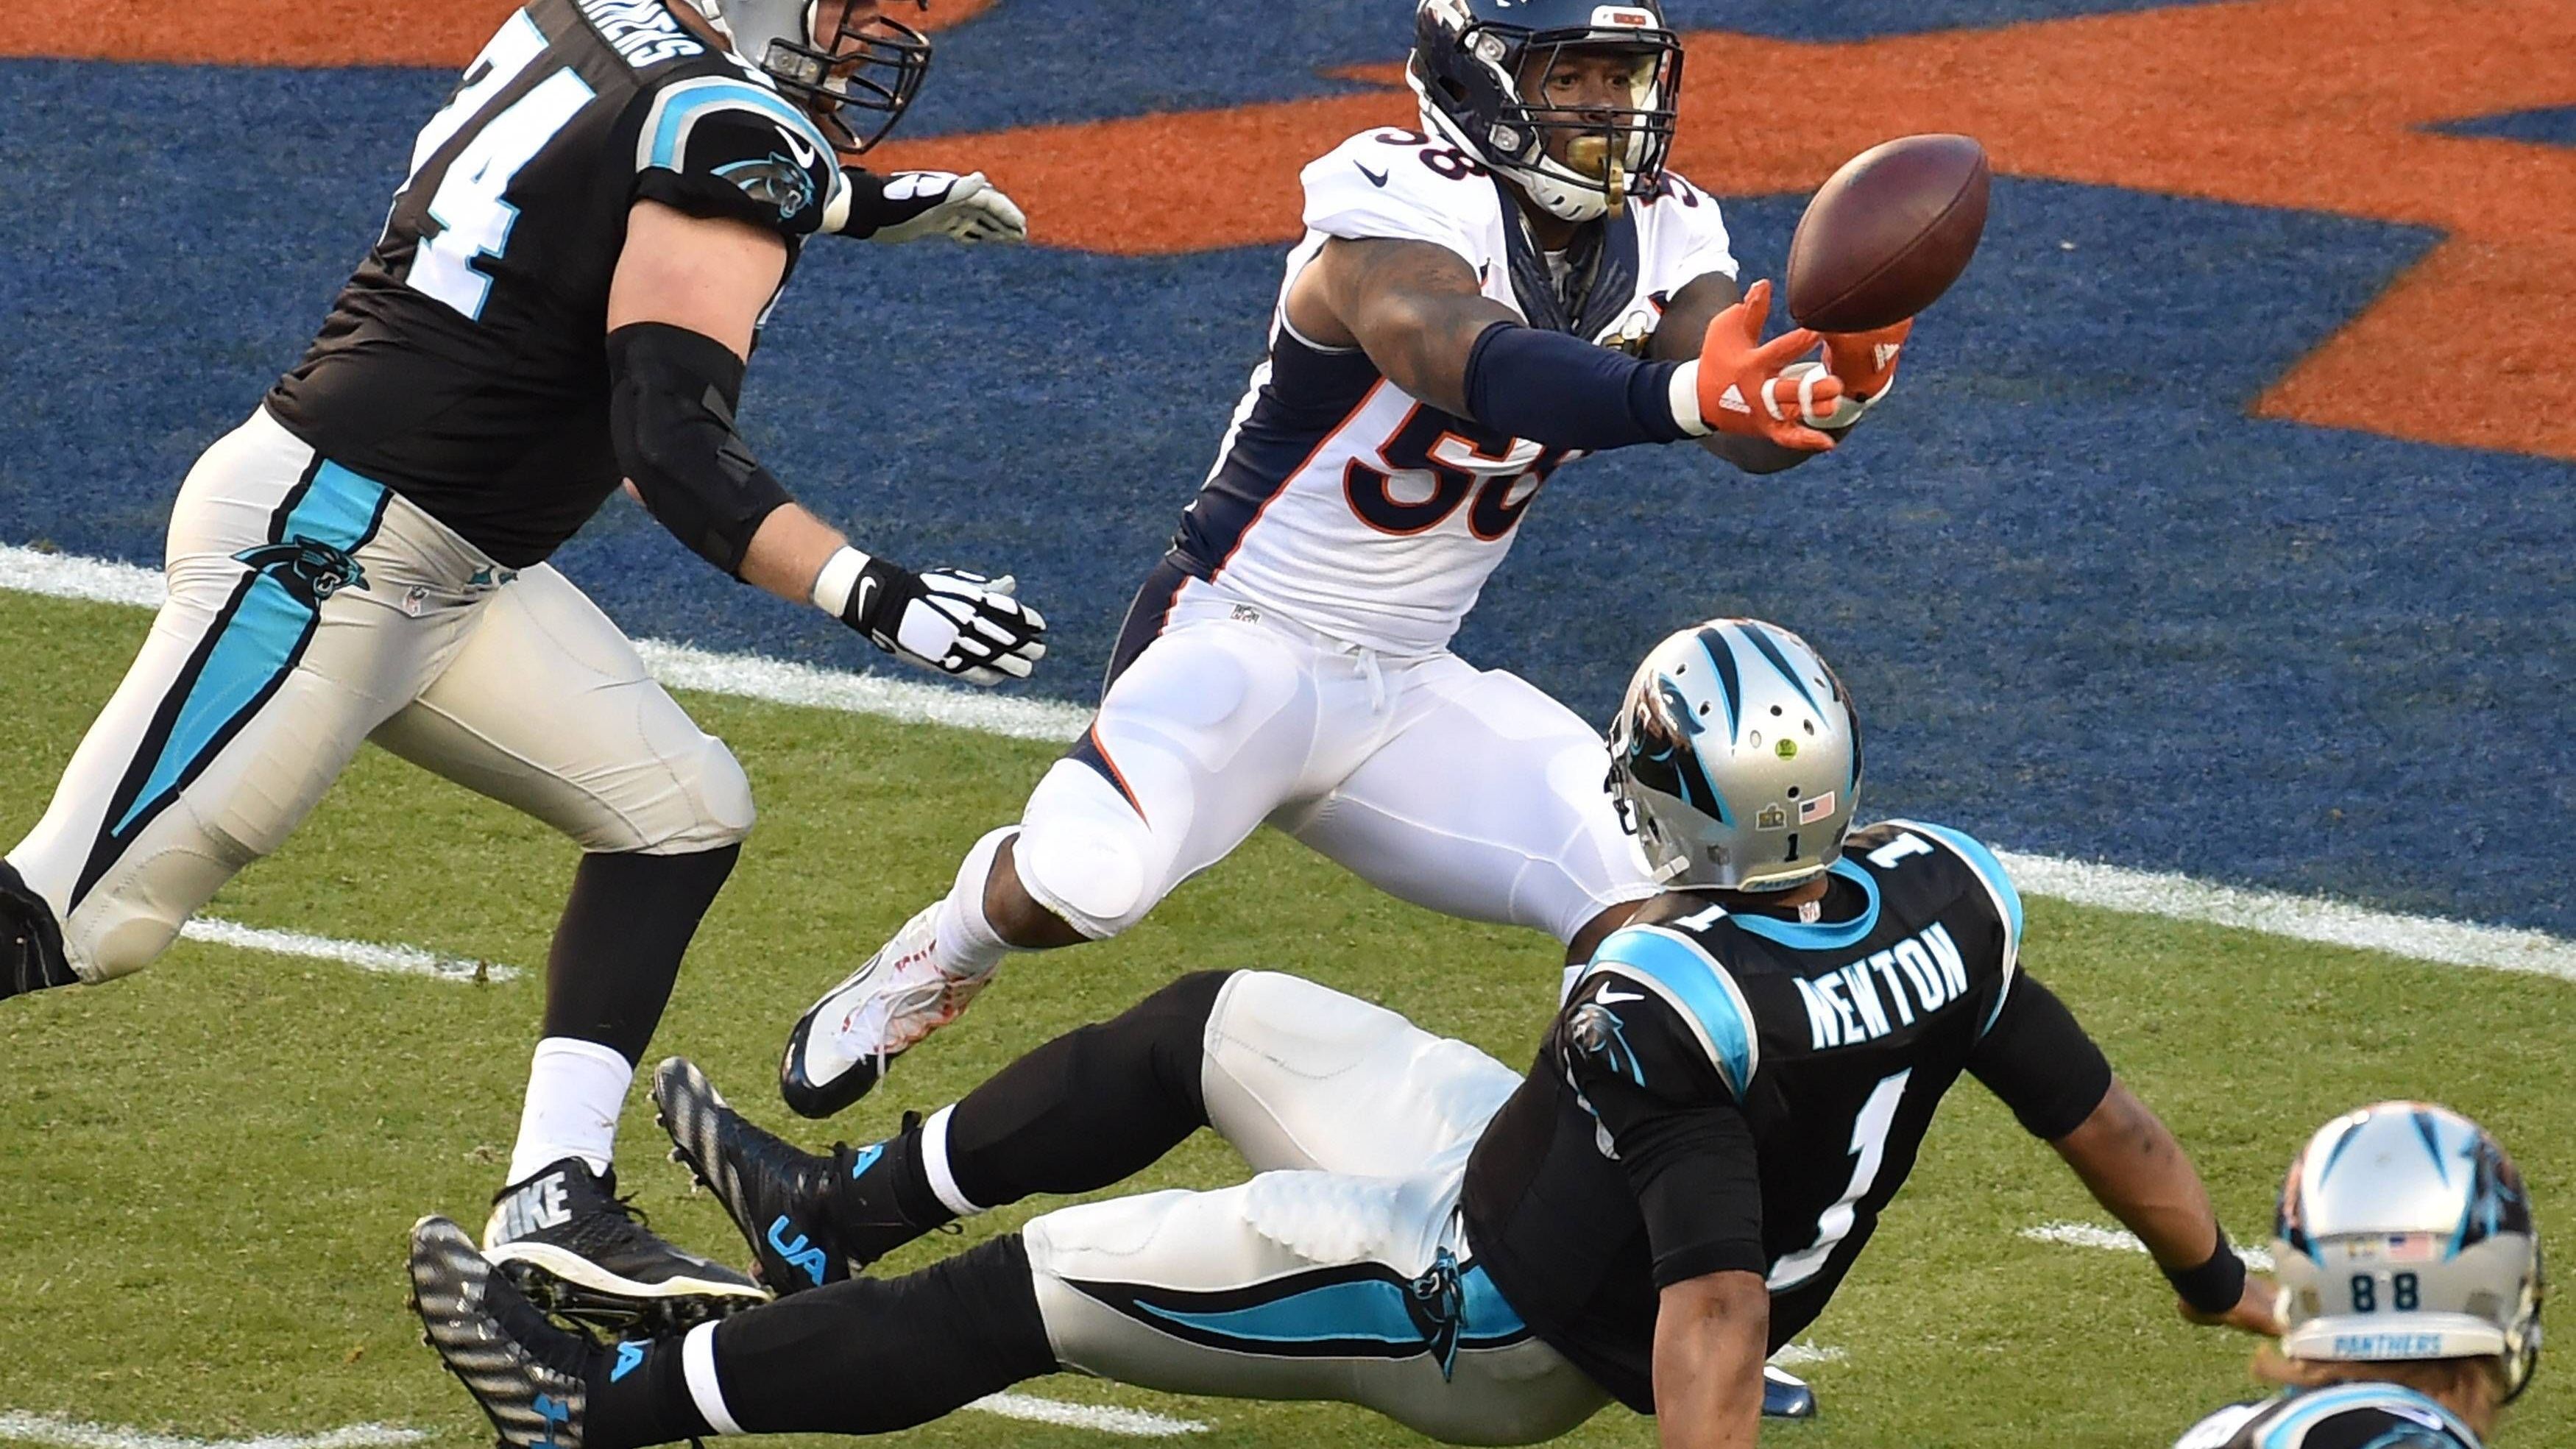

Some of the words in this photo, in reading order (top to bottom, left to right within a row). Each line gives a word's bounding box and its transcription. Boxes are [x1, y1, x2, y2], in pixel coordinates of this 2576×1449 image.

[394, 6, 598, 322] 74
[1784, 833, 1799, 862] 1
[1866, 832, 1935, 868] 1
[1673, 903, 1728, 932] 1
[1792, 921, 1968, 1051] NEWTON
[1765, 1067, 1913, 1290] 1
[768, 1215, 826, 1287] UA
[2352, 1272, 2418, 1314] 88
[2335, 1333, 2442, 1358] PANTHERS
